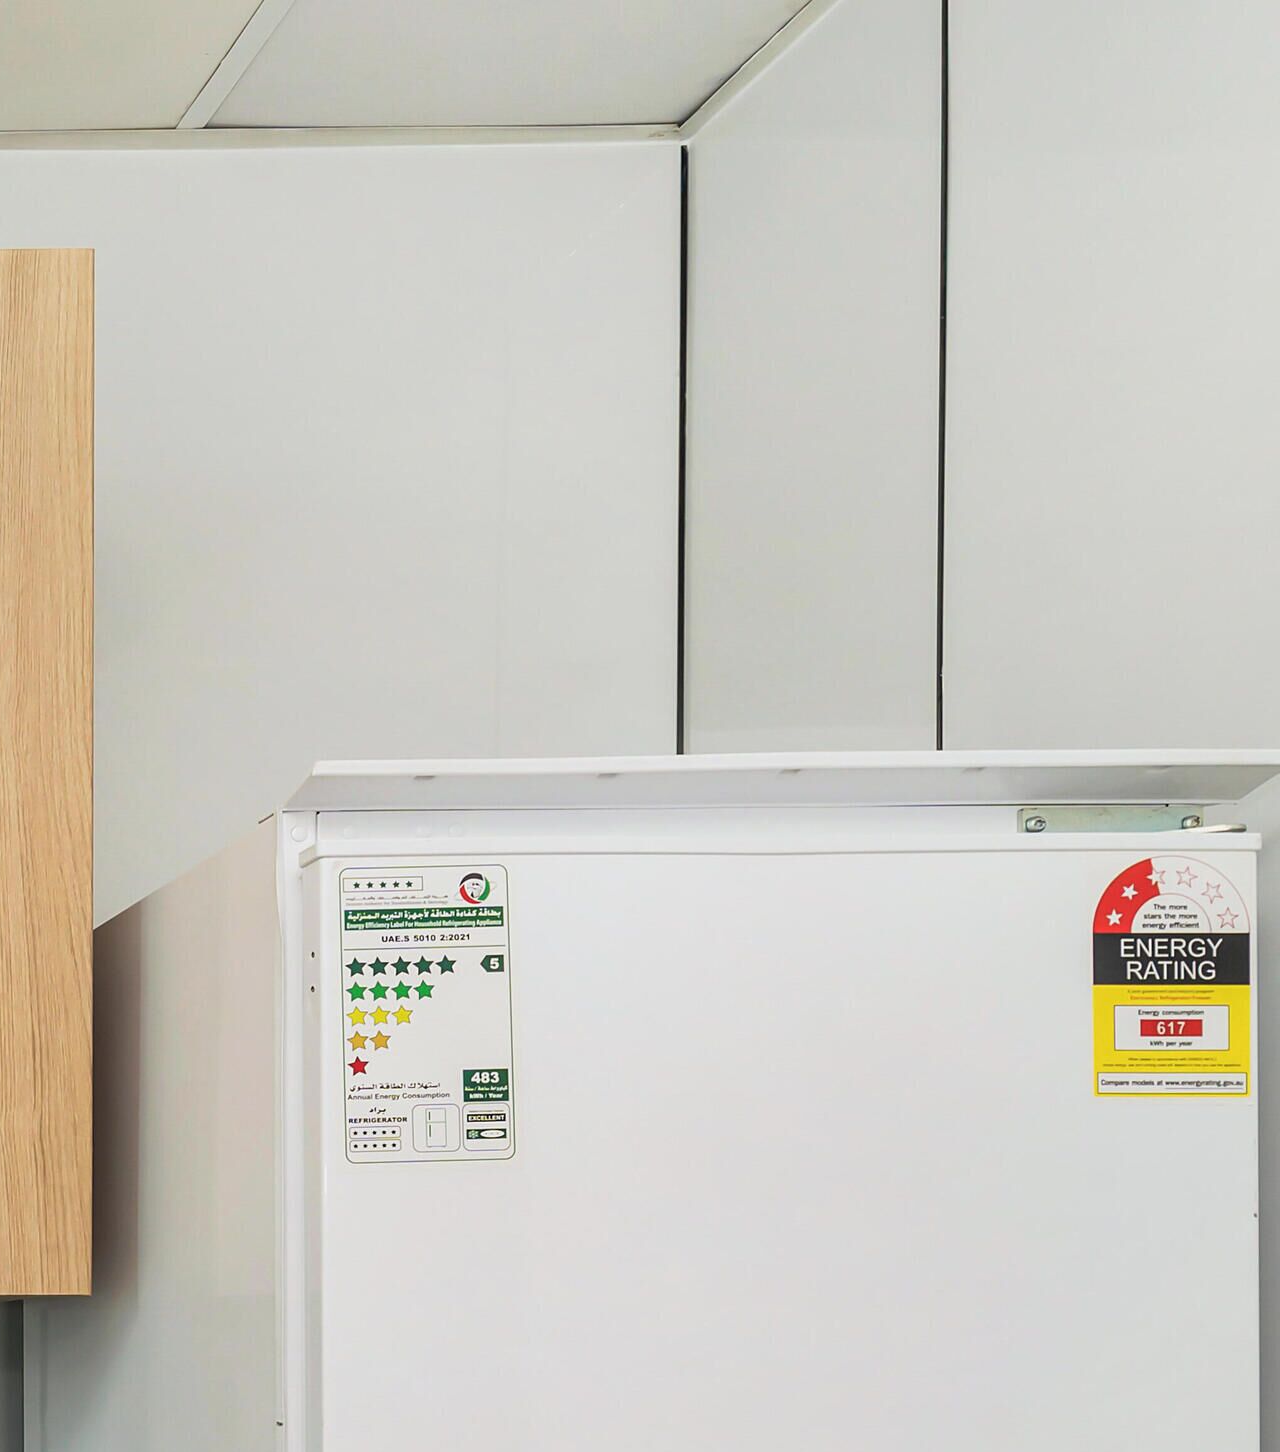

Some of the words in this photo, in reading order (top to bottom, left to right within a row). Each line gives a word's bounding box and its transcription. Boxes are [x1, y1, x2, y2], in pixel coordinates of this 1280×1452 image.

[381, 935, 410, 943] UAE.S
[414, 934, 436, 942] 5010
[440, 933, 470, 941] 2:2021
[1120, 938, 1223, 957] ENERGY
[490, 958, 499, 970] 5
[1126, 961, 1216, 980] RATING
[1138, 1009, 1159, 1017] Energy
[1162, 1009, 1204, 1017] consumption
[1156, 1021, 1186, 1035] 617
[471, 1072, 500, 1084] 483
[1101, 1079, 1129, 1087] Compare
[374, 1093, 400, 1101] Energy
